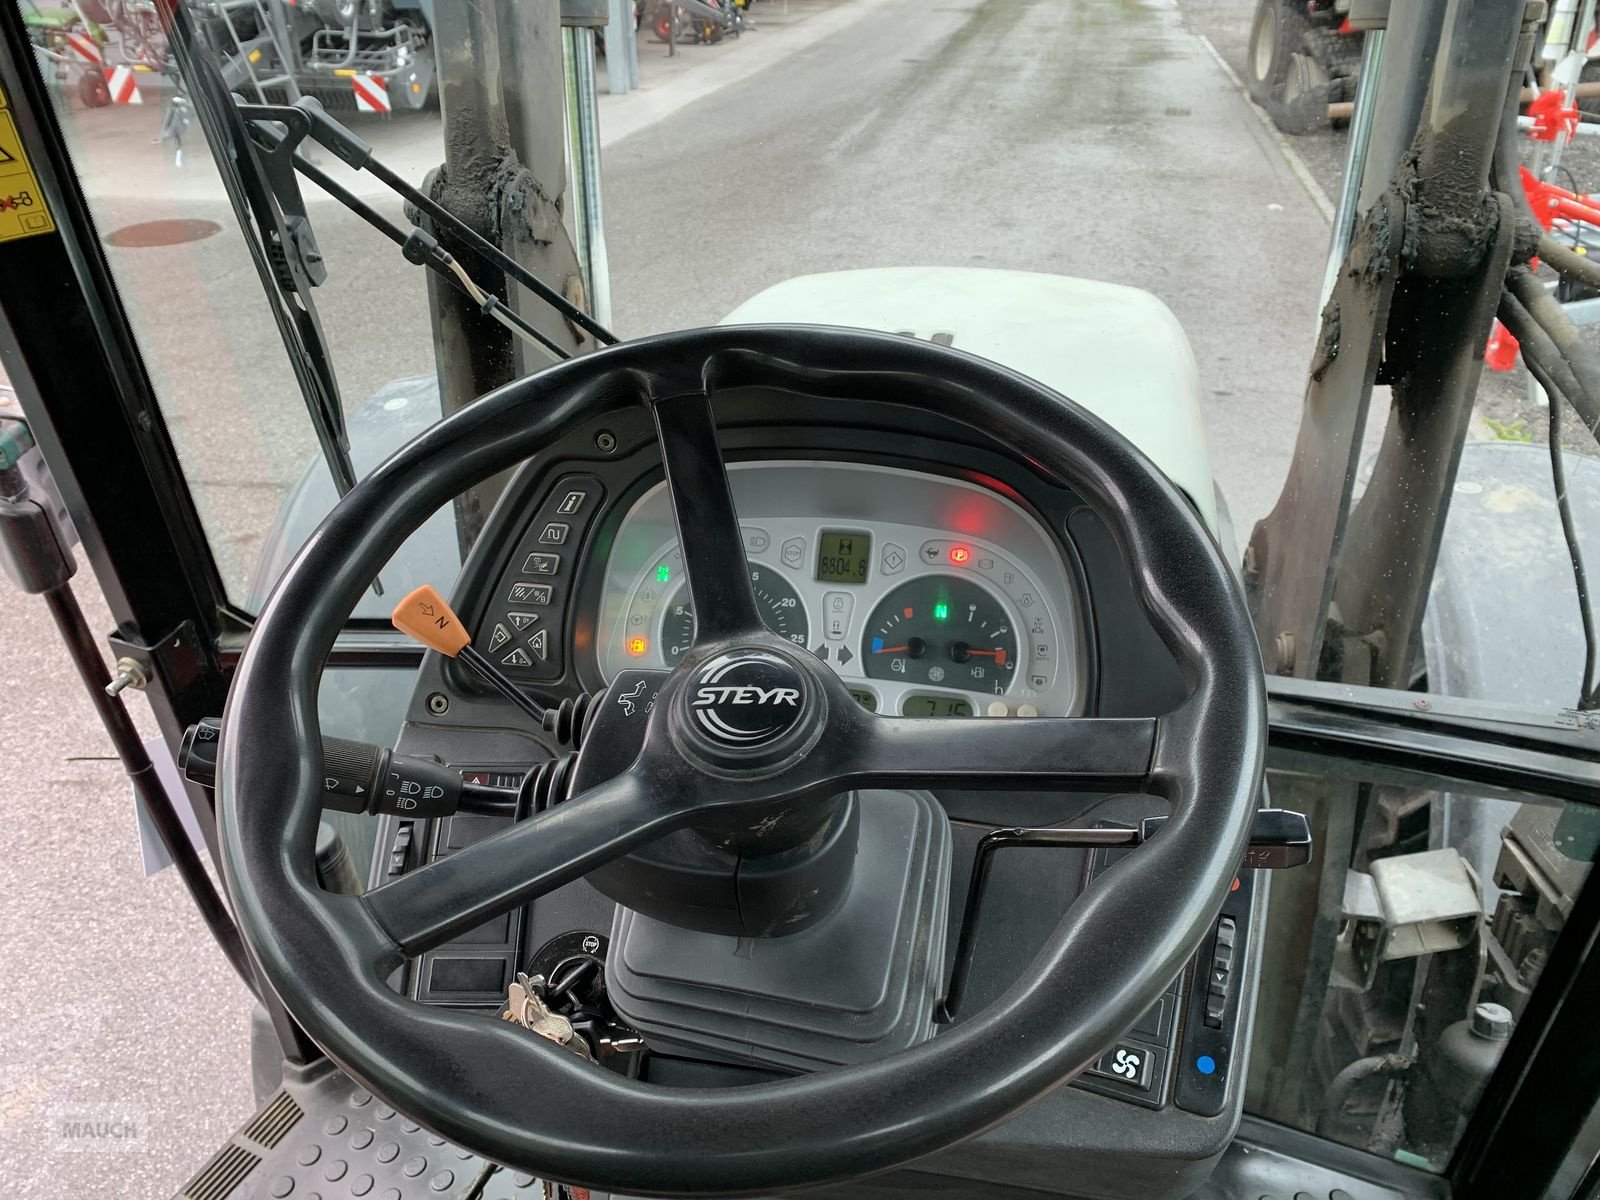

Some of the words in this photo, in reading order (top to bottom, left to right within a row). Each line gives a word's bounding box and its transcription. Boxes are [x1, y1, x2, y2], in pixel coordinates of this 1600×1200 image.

[821, 557, 866, 577] 8804.6
[781, 598, 796, 608] 20
[676, 606, 684, 616] 5
[934, 604, 948, 619] N
[434, 616, 450, 630] N
[790, 634, 805, 644] 25
[671, 646, 679, 655] 0
[691, 686, 800, 706] STEYR
